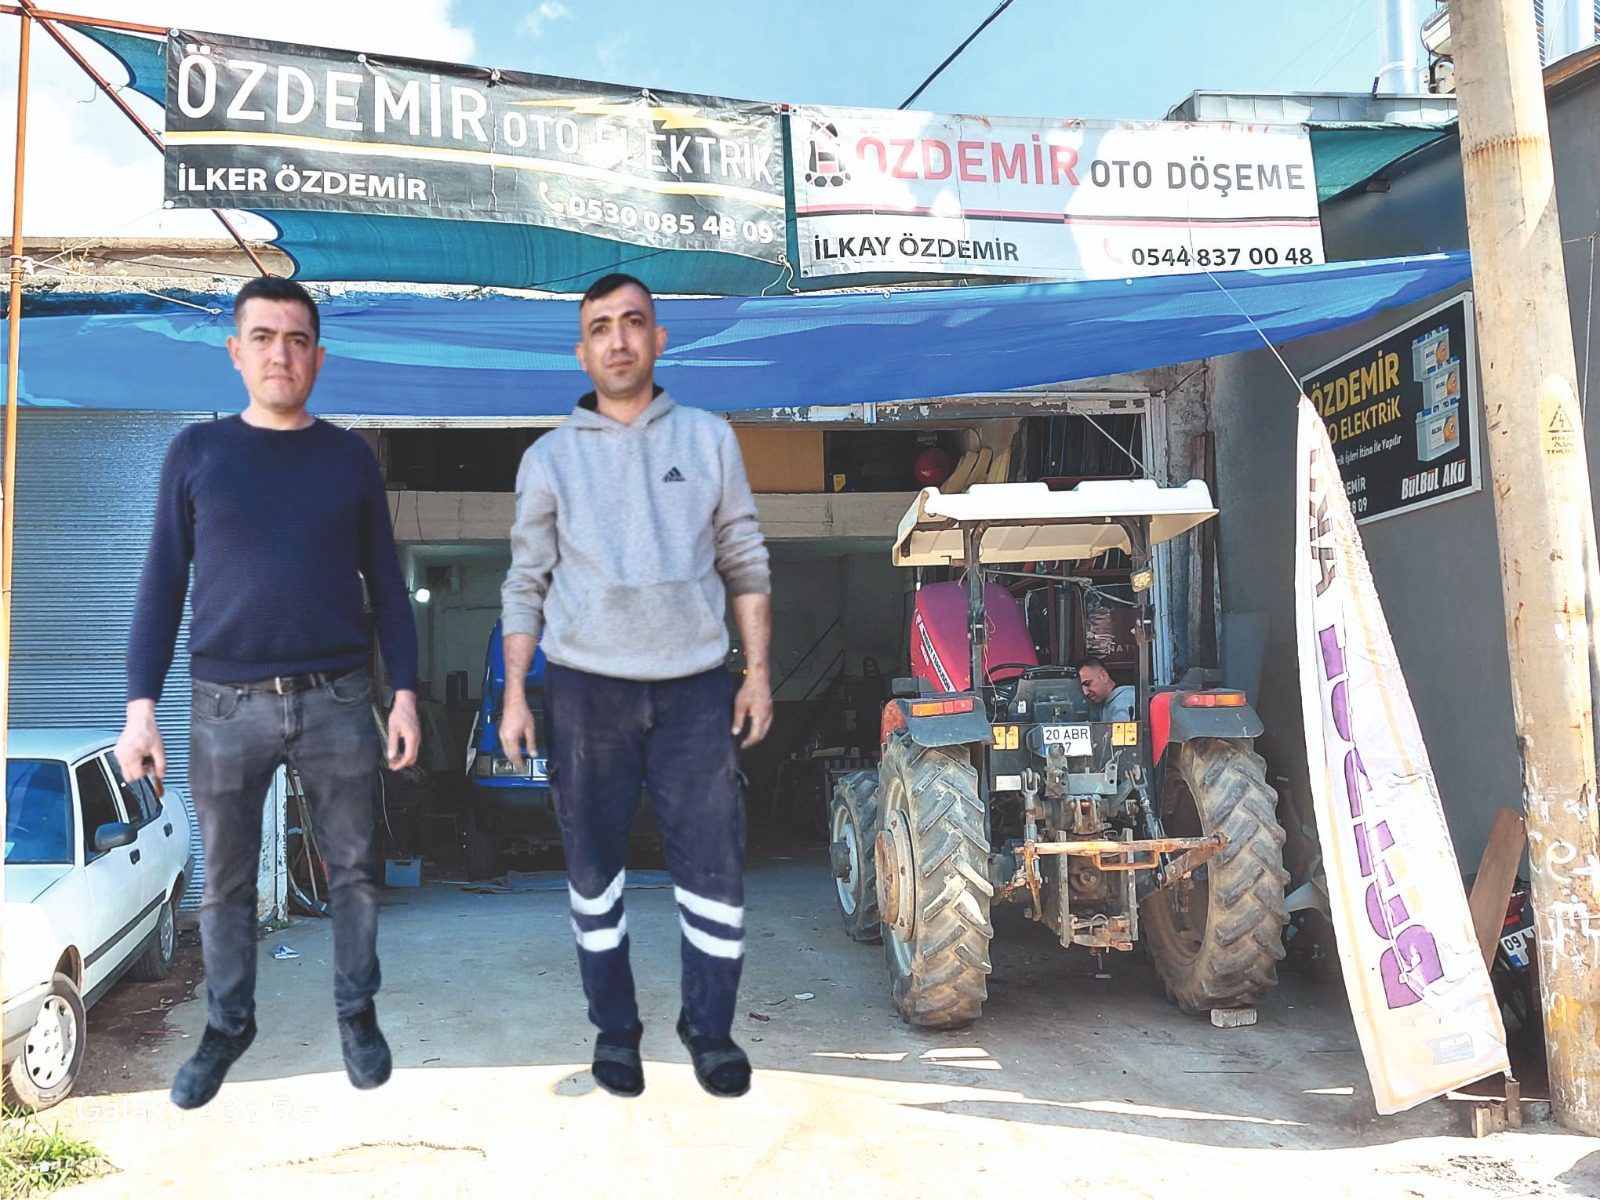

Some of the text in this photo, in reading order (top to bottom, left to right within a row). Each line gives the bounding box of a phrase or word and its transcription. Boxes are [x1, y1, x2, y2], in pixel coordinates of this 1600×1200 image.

[177, 43, 489, 142] ÖZDEMİR
[503, 111, 579, 154] OTO
[178, 162, 428, 201] İLKER ÖZDEMİR
[856, 127, 1305, 197] ÖZDEMİR OTO DÖŞEME
[568, 194, 774, 244] 0530 085 48 09
[814, 233, 1019, 262] İLKAY ÖZDEMİR
[1131, 247, 1313, 267] 0544 837 00 48
[1310, 351, 1400, 418] ÖZDEMİR
[1340, 395, 1402, 441] ELEKTRİK
[1346, 473, 1367, 496] EMİR
[1401, 458, 1467, 500] BÜLBÜL AKÜ
[1357, 496, 1368, 513] 09
[1045, 728, 1089, 741] 20 ABR
[1504, 935, 1521, 951] 09
